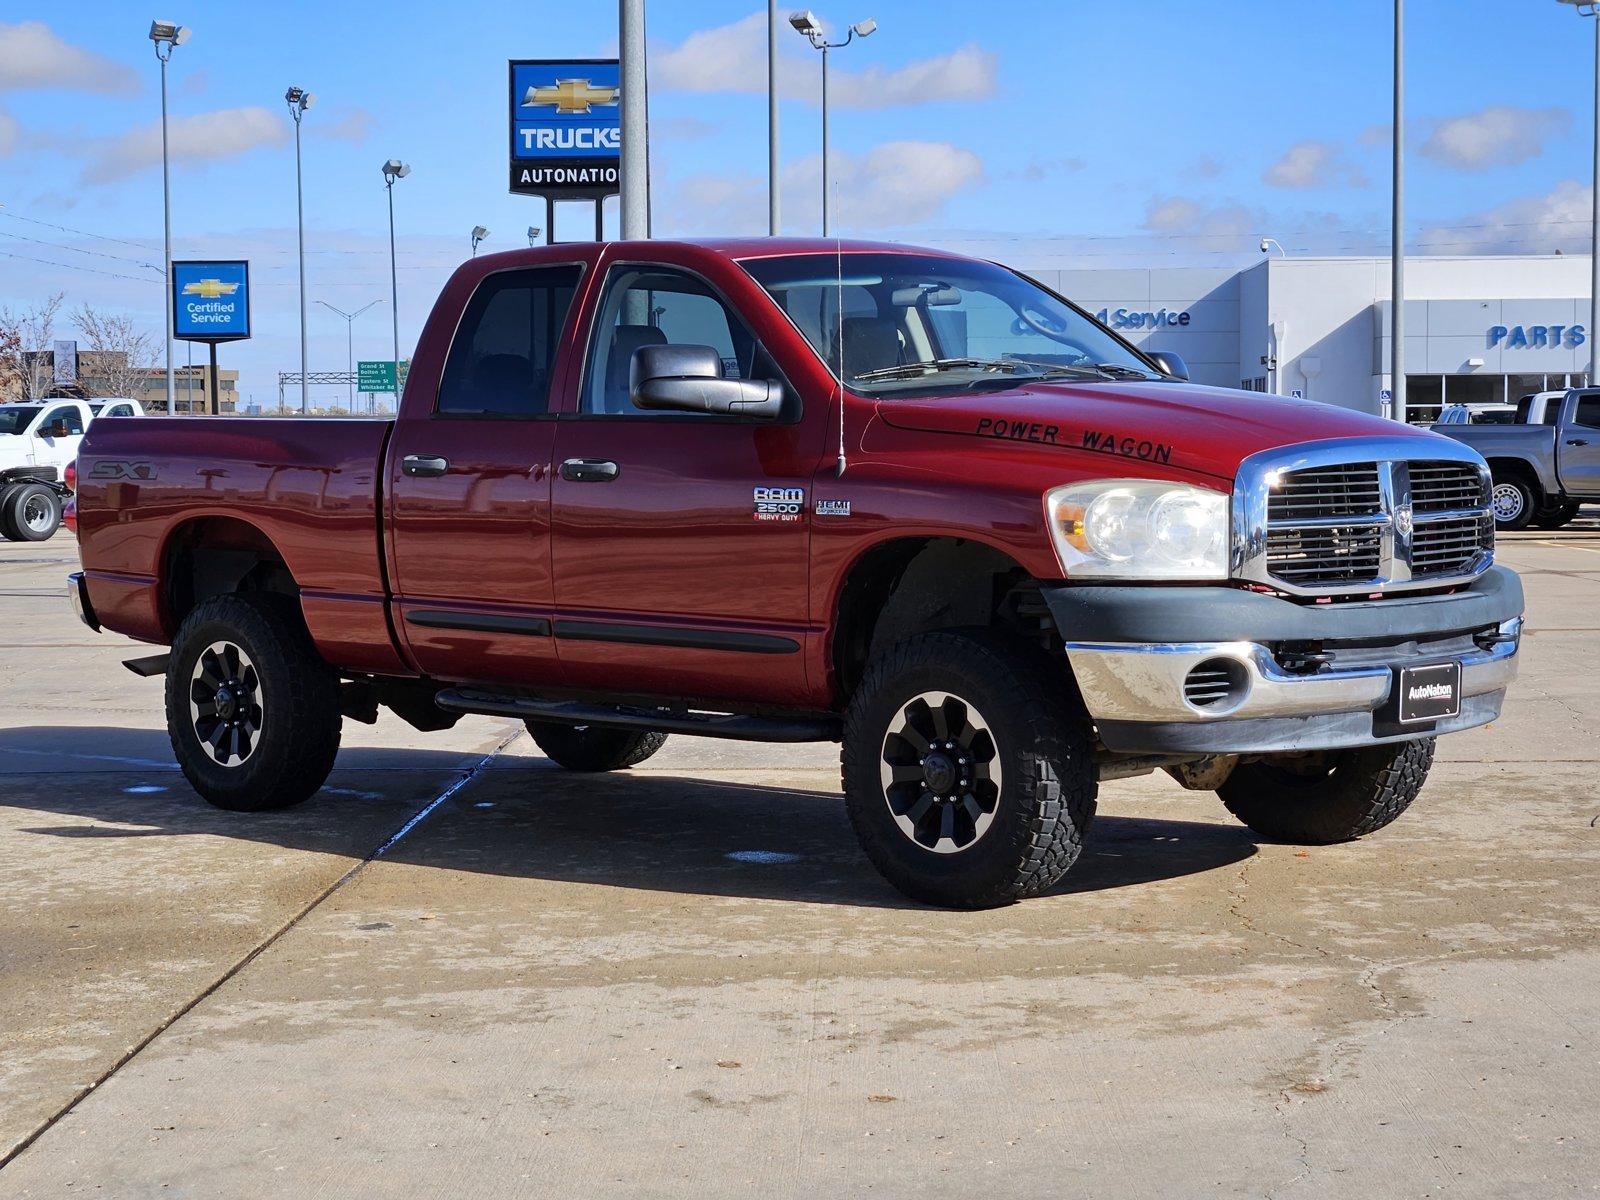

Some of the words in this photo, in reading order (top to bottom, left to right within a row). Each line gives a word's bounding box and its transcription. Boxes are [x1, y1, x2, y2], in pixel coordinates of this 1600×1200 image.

[520, 168, 620, 183] AUTONATIO
[187, 303, 235, 313] Certified
[191, 313, 231, 323] Service
[1112, 308, 1191, 328] Service
[1487, 325, 1586, 350] PARTS
[976, 418, 1060, 443] POWER
[1082, 430, 1171, 463] WAGON
[753, 486, 804, 504] RAM
[757, 503, 800, 514] 2500
[758, 513, 779, 521] HEAVY
[781, 513, 799, 521] DUTY
[1408, 684, 1452, 699] AutoNation
